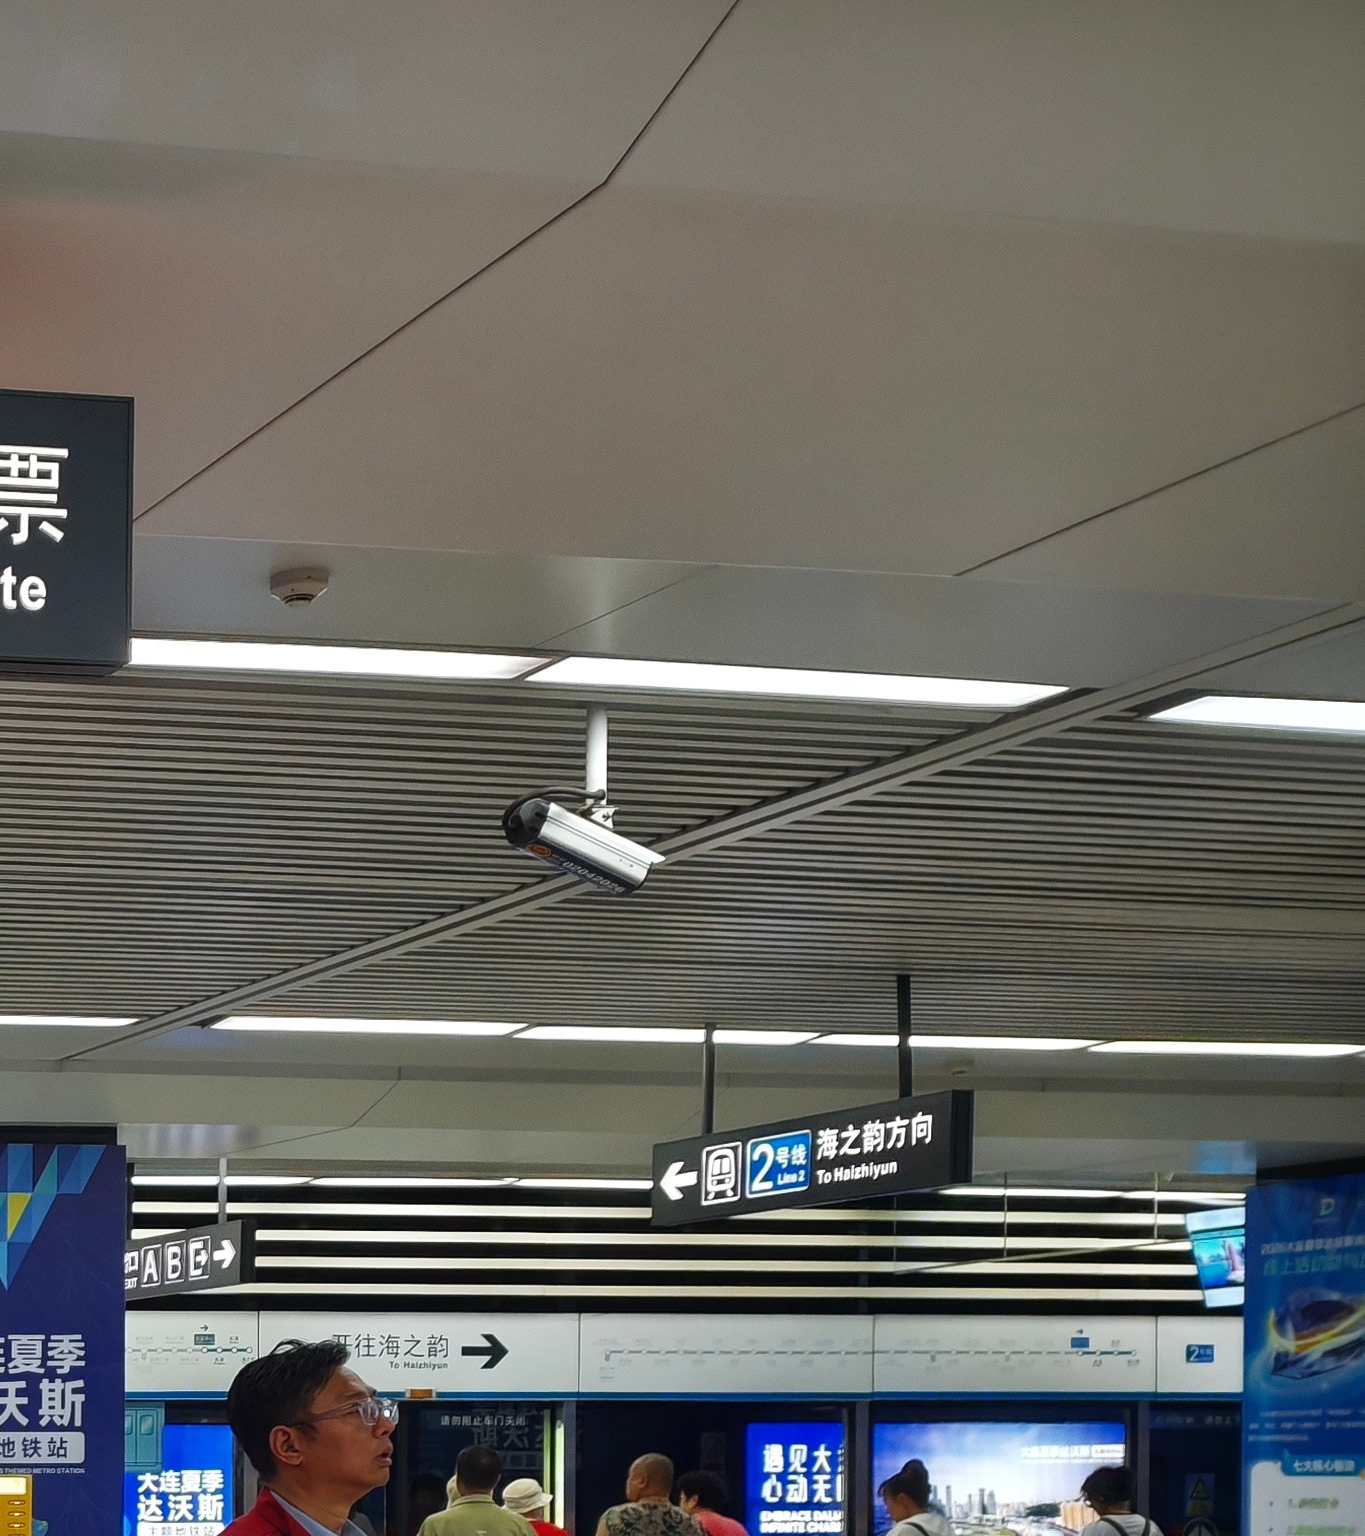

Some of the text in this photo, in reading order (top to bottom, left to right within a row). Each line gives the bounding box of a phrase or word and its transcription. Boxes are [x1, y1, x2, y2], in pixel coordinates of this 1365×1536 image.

[817, 1111, 934, 1161] 海之韵方向
[817, 1160, 898, 1186] To Haizhiyun
[389, 1361, 400, 1370] To
[763, 1444, 844, 1473] 遇见大
[137, 1470, 224, 1493] 大连夏季
[137, 1494, 224, 1521] 达沃斯
